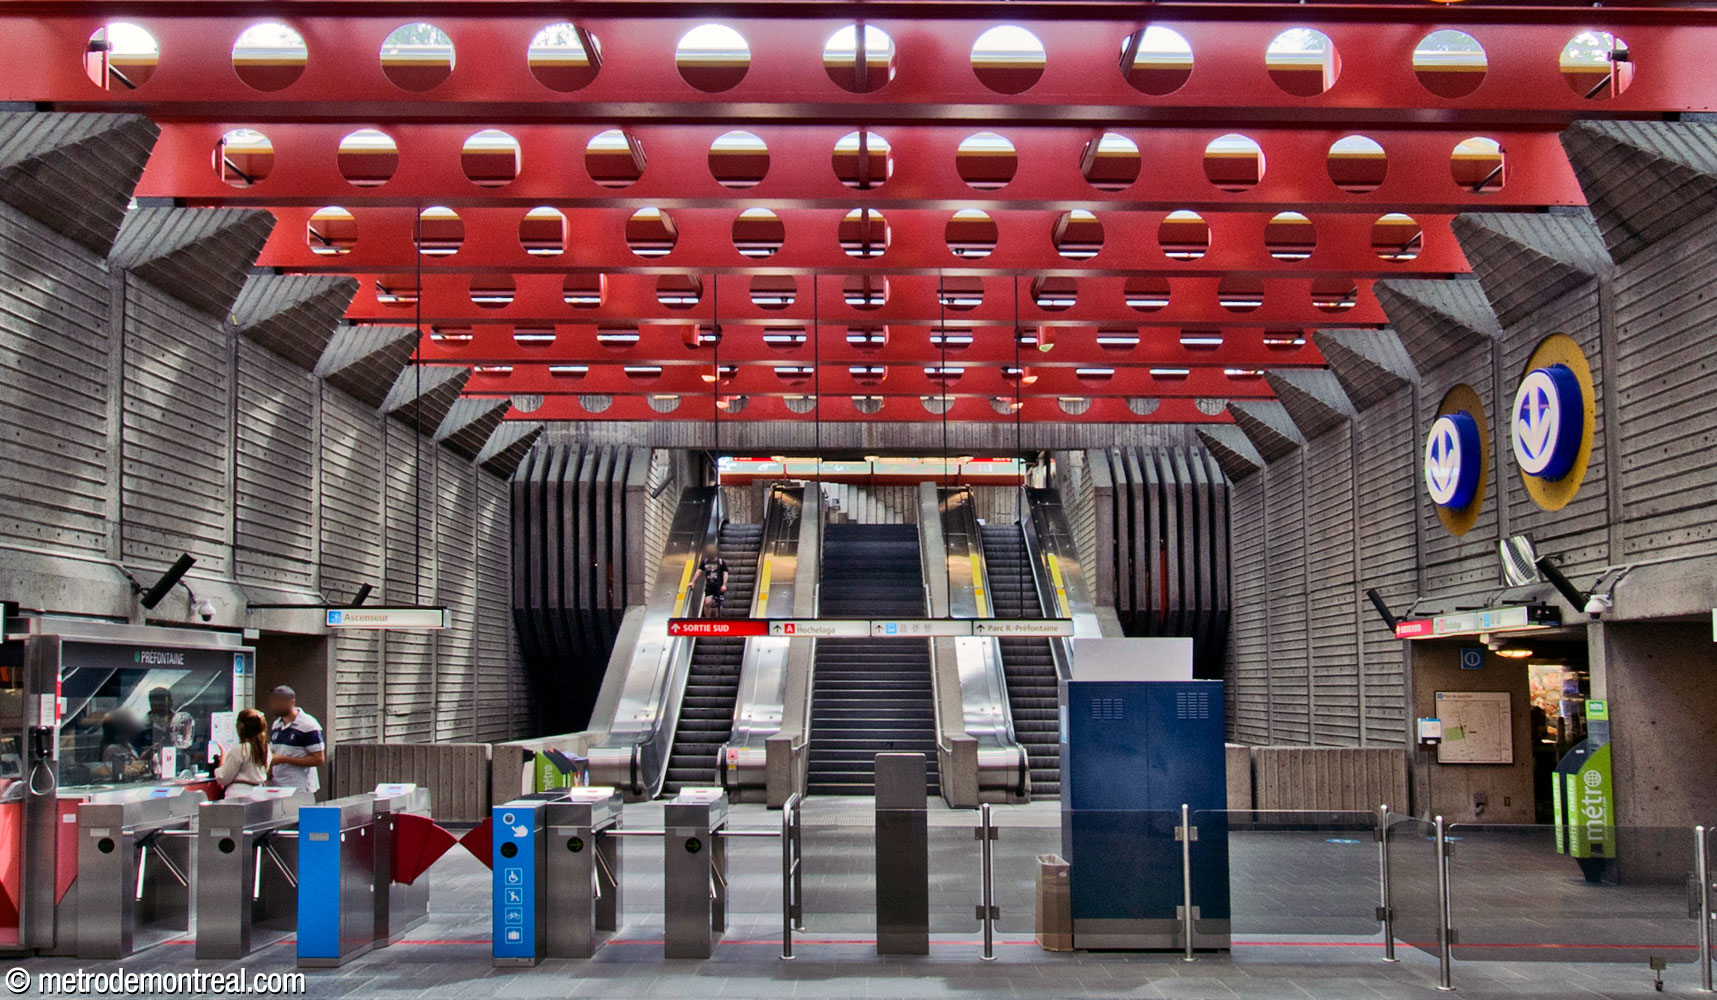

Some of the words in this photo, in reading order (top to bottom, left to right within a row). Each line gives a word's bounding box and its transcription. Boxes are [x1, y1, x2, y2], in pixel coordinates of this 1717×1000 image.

[344, 613, 389, 622] Ascenseur
[683, 624, 711, 632] SORTIE
[712, 624, 730, 632] SUD
[786, 624, 794, 632] A
[797, 625, 836, 635] Hochelaga
[1582, 770, 1603, 841] métro
